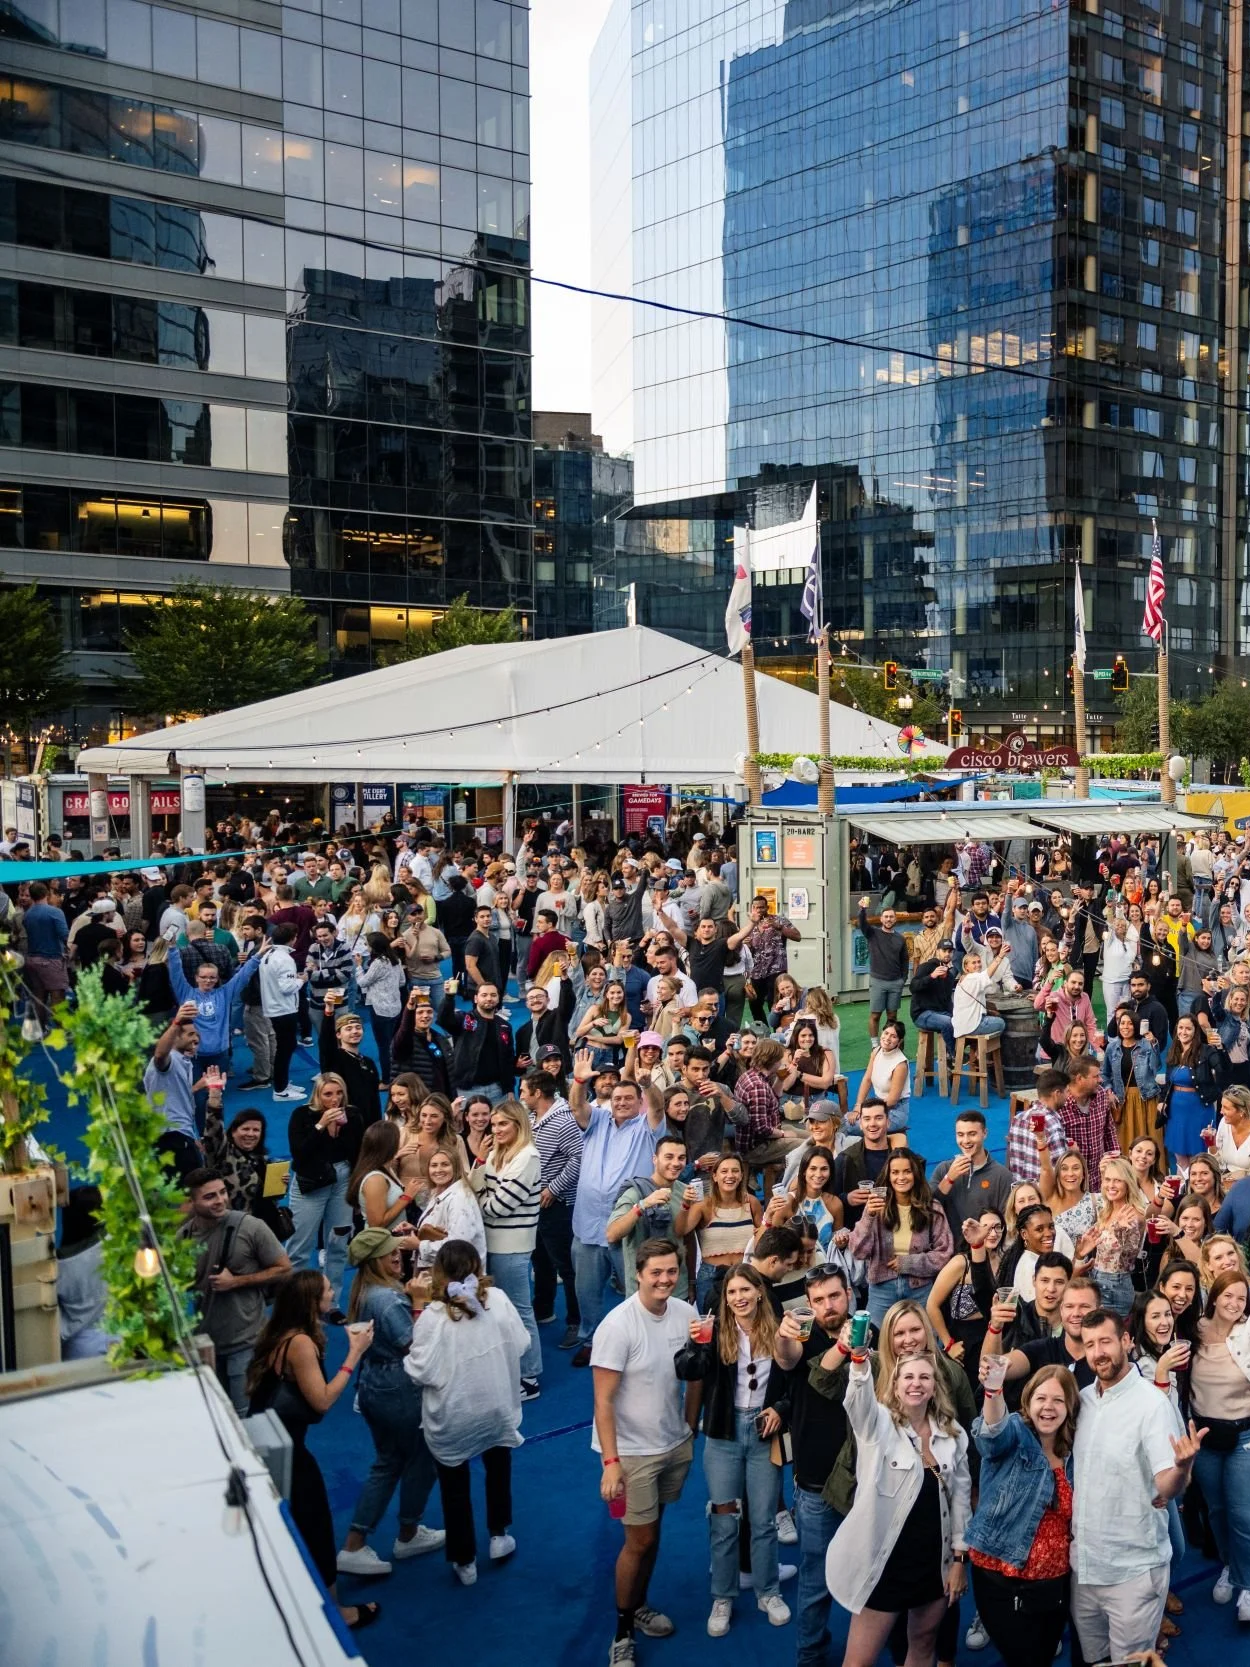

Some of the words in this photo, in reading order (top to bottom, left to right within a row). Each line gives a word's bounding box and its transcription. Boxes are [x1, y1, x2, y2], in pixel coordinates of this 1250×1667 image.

[960, 751, 1002, 767] cisco
[1007, 752, 1069, 767] brewers
[112, 796, 180, 808] COAILS
